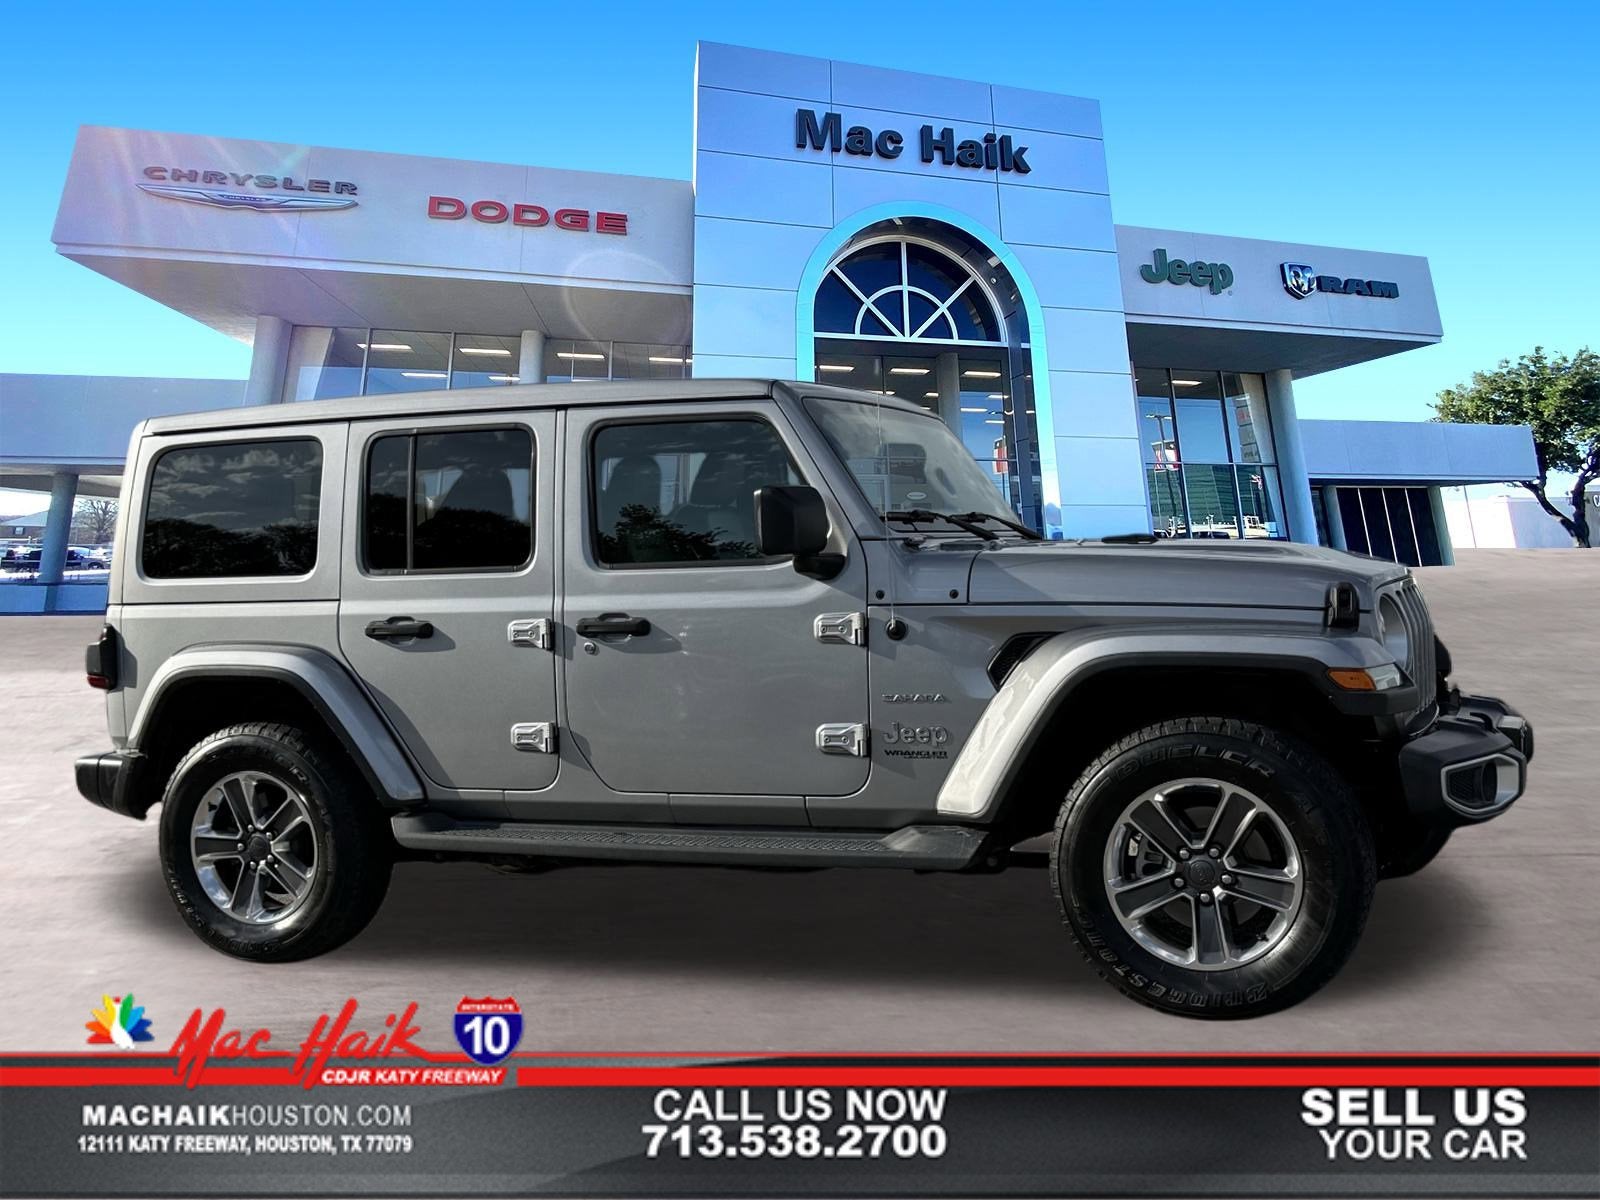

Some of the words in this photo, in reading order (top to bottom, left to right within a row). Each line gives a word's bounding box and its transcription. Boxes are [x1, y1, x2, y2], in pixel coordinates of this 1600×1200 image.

[796, 108, 904, 160] Mac
[919, 124, 1032, 174] Haik
[143, 166, 359, 196] CHRYSLER
[428, 196, 628, 236] DODGE
[1140, 248, 1234, 295] Jeep
[1316, 275, 1399, 299] RAM
[883, 721, 949, 749] Jeep
[884, 750, 948, 758] WRANGLER
